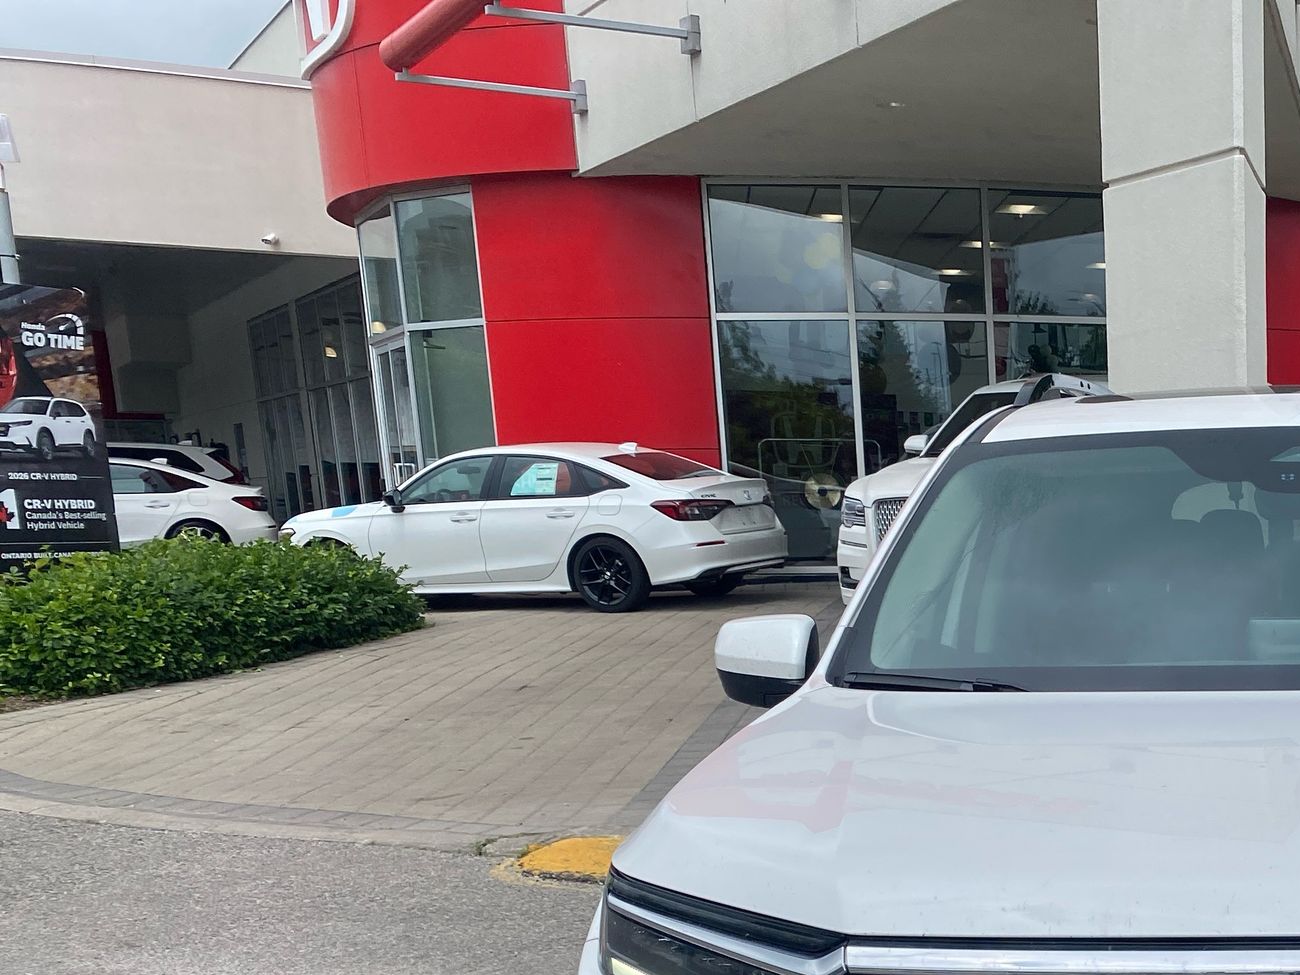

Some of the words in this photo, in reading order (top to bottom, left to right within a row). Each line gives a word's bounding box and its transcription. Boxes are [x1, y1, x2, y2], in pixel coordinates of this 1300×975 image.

[21, 331, 46, 347] GO
[47, 333, 85, 351] TIME
[8, 472, 29, 480] 2026
[50, 473, 78, 481] HYBRID
[23, 499, 52, 509] CR-V
[54, 499, 95, 510] HYBRID
[25, 511, 63, 520] Canada's
[64, 511, 107, 521] Best-selling
[26, 521, 56, 531] Hybrid
[56, 521, 85, 529] Vehicle
